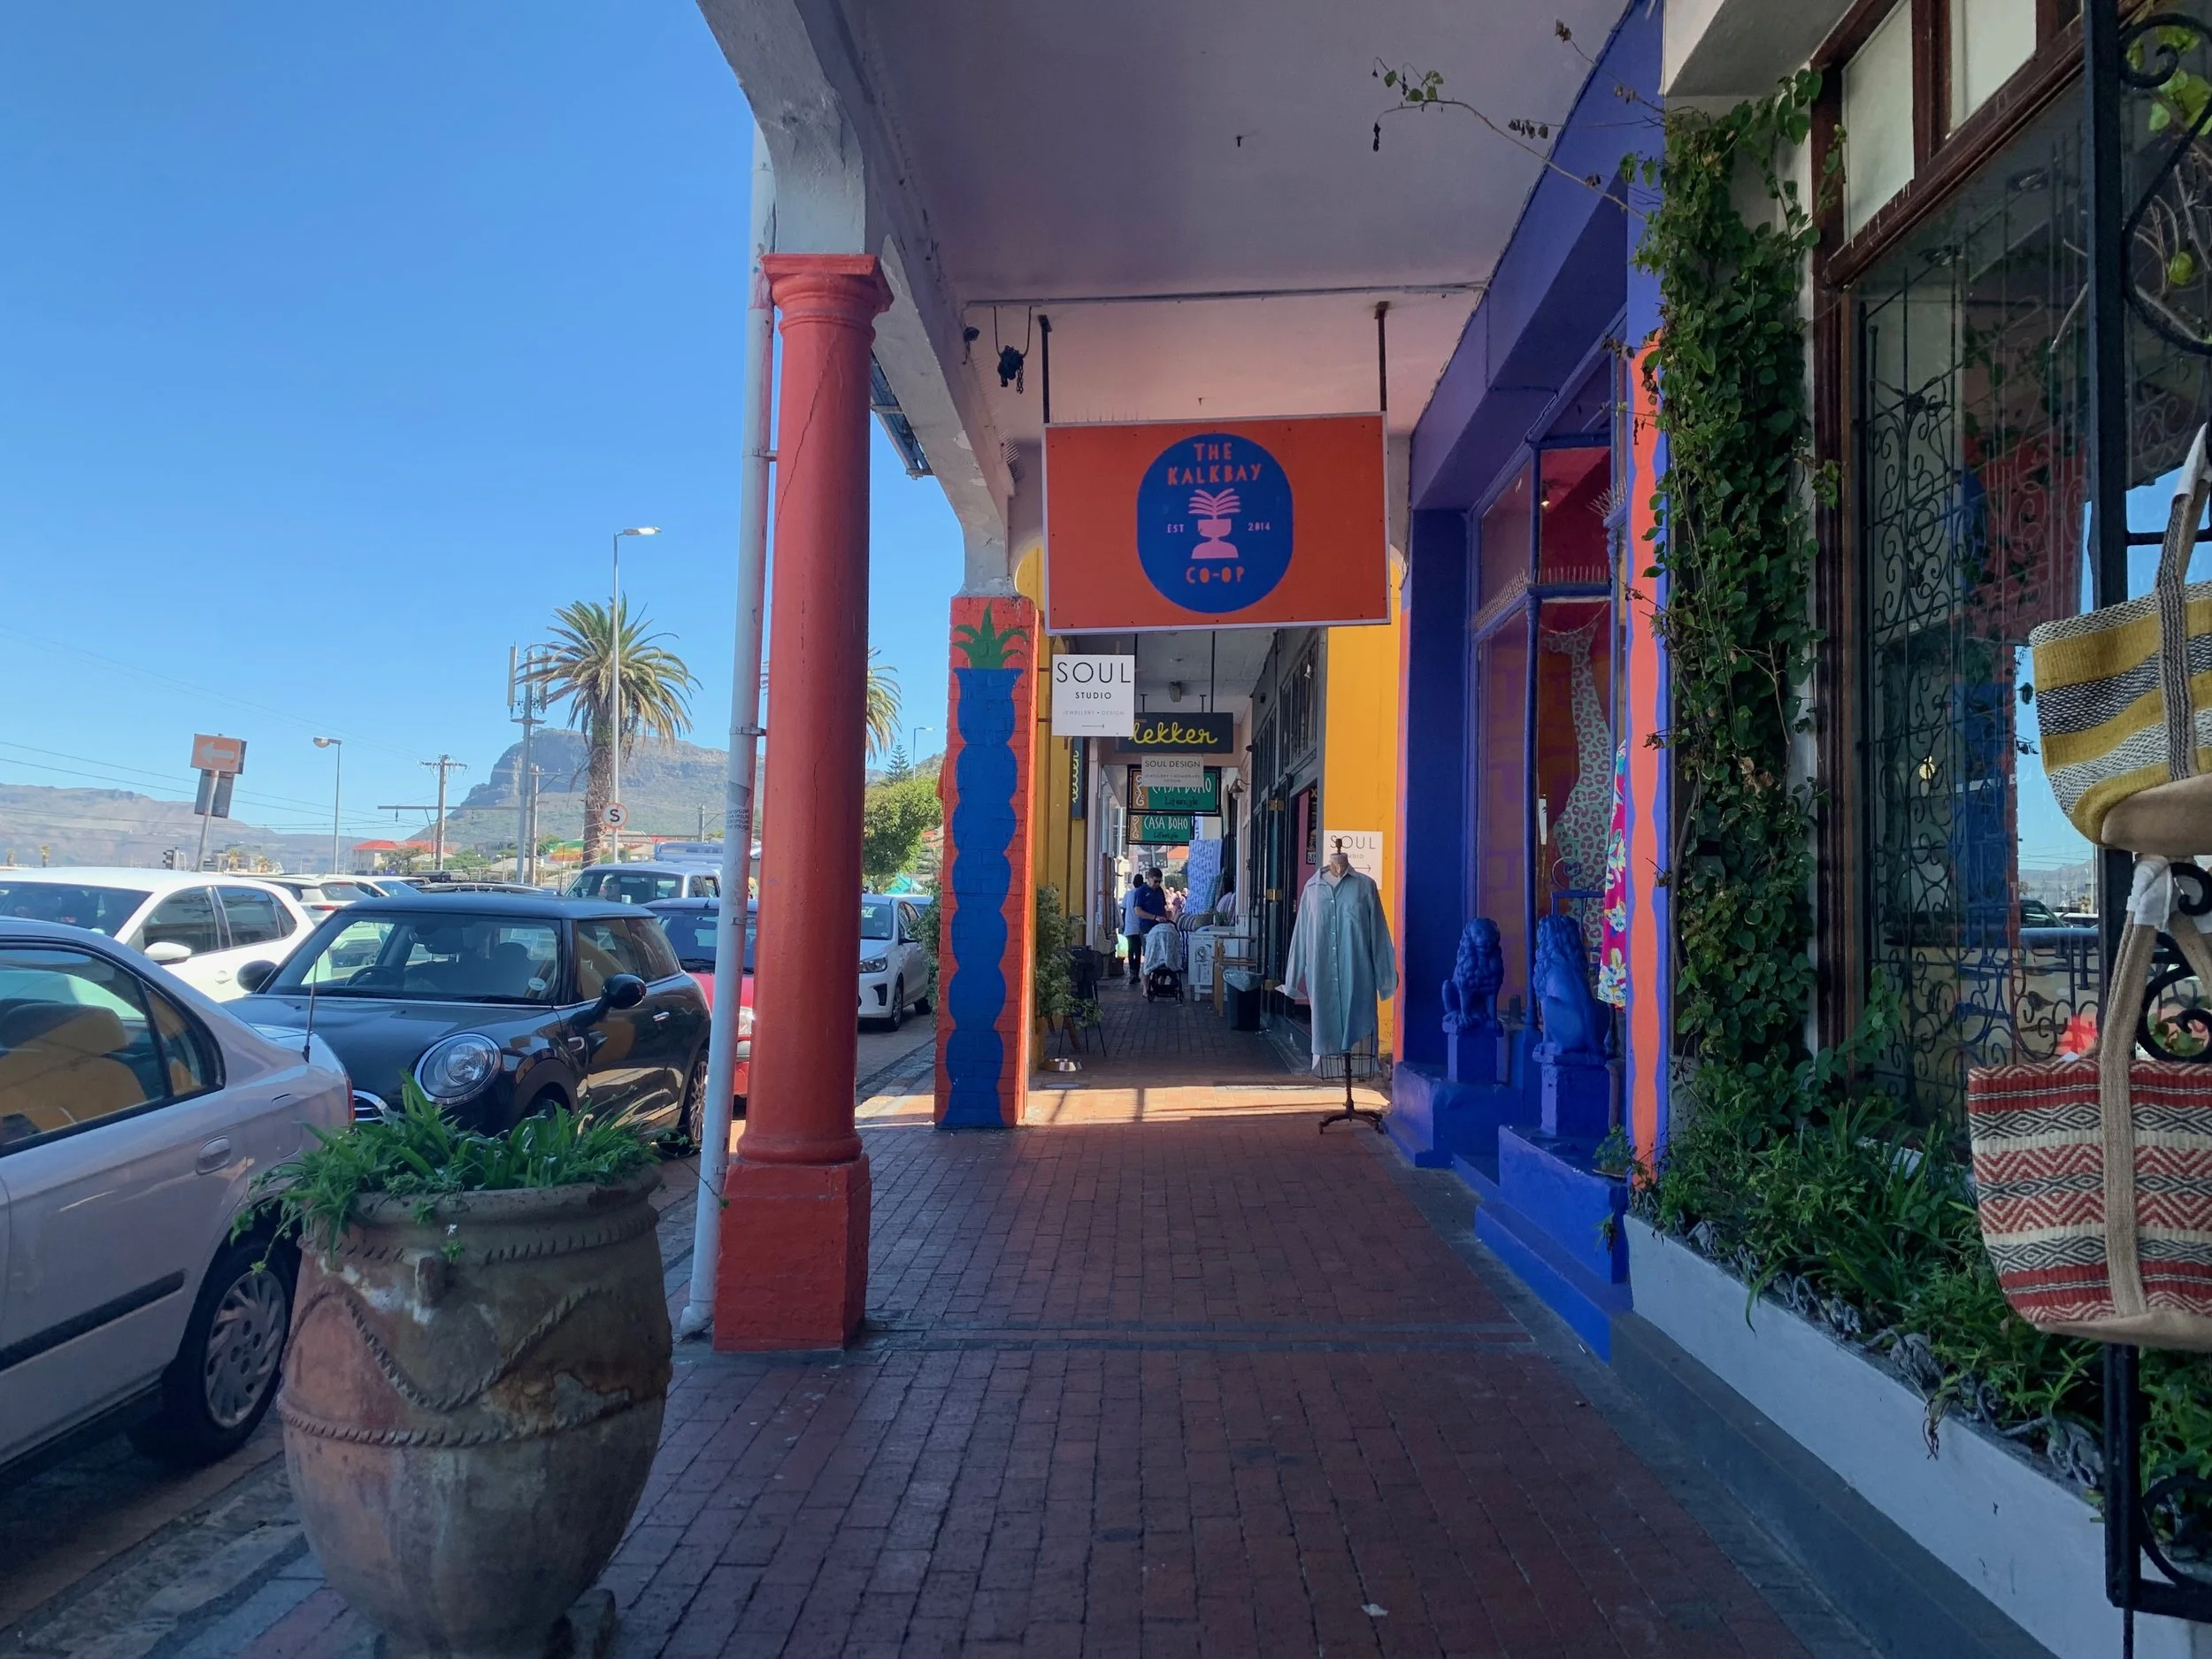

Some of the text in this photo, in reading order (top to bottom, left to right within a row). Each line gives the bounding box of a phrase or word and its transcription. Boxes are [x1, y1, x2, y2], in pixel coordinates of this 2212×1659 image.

[1193, 442, 1233, 462] THE
[1167, 463, 1262, 486] KALKBAY
[1167, 523, 1185, 534] EST
[1248, 521, 1271, 532] 2014
[1186, 565, 1246, 584] CO-OP
[1056, 661, 1132, 684] SOUL
[1075, 691, 1112, 700] STUDIO
[1128, 721, 1218, 744] lekker
[609, 809, 620, 823] S
[1143, 815, 1166, 830] CASA
[1168, 816, 1188, 830] BOHO
[1330, 835, 1376, 849] SOUL
